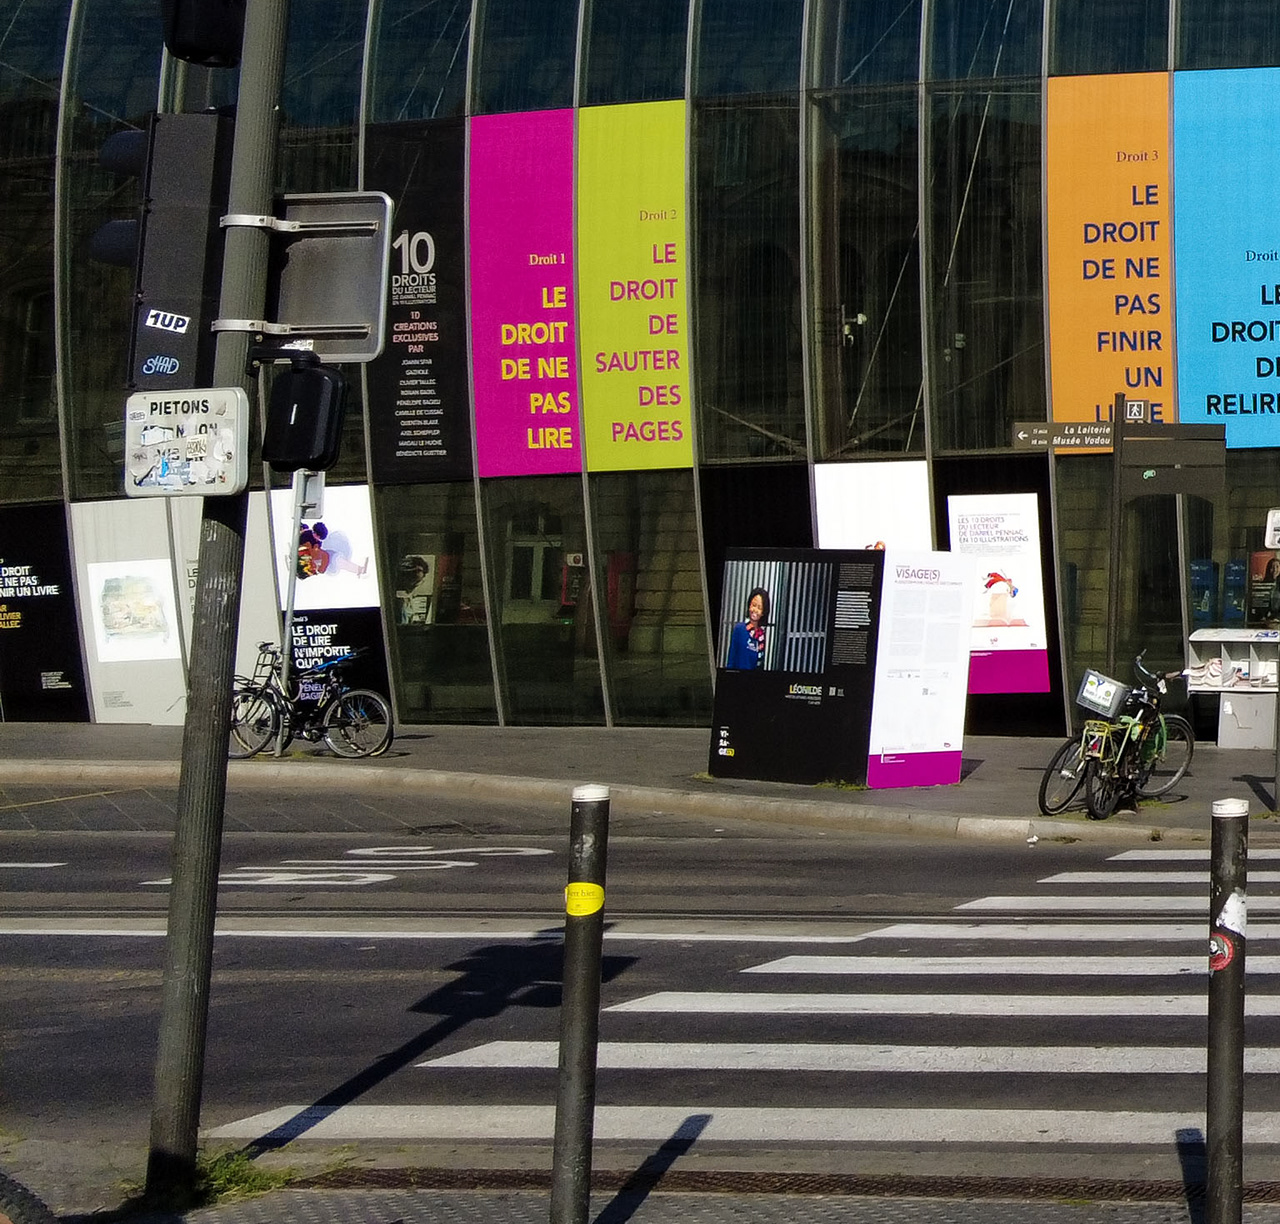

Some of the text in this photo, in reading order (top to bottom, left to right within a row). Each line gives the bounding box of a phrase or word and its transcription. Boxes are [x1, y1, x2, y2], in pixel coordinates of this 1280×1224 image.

[1116, 150, 1159, 163] Droit 3
[1132, 185, 1158, 206] LE
[640, 209, 677, 221] Droit 2
[1083, 221, 1159, 244] DROIT
[392, 232, 435, 273] 10
[529, 254, 566, 265] Droit 1
[653, 243, 677, 264] LE
[1245, 250, 1278, 262] Droit
[1082, 257, 1159, 280] DE NE
[392, 273, 436, 286] DROITS
[405, 286, 436, 294] LECTEUR
[610, 279, 678, 301] DROIT
[542, 287, 566, 308] LE
[1114, 294, 1161, 315] PAS
[150, 312, 187, 330] 1UP
[649, 314, 678, 335] DE
[502, 322, 568, 345] DROIT
[1097, 330, 1162, 352] FINIR
[502, 357, 569, 380] DE NE
[596, 350, 680, 373] SAUTER
[1125, 367, 1162, 388] UN
[530, 392, 571, 414] PAS
[639, 385, 681, 406] DES
[150, 399, 209, 415] PIETONS
[1096, 403, 1163, 423] LIE
[528, 427, 572, 449] LIRE
[612, 421, 683, 442] PAGES
[1064, 425, 1111, 434] La Laiterie
[1052, 436, 1080, 445] Musée
[1084, 436, 1111, 445] Vodou
[896, 568, 940, 581] VISAGE(S)
[292, 624, 338, 636] LE DROIT
[293, 636, 332, 646] DE LIRE
